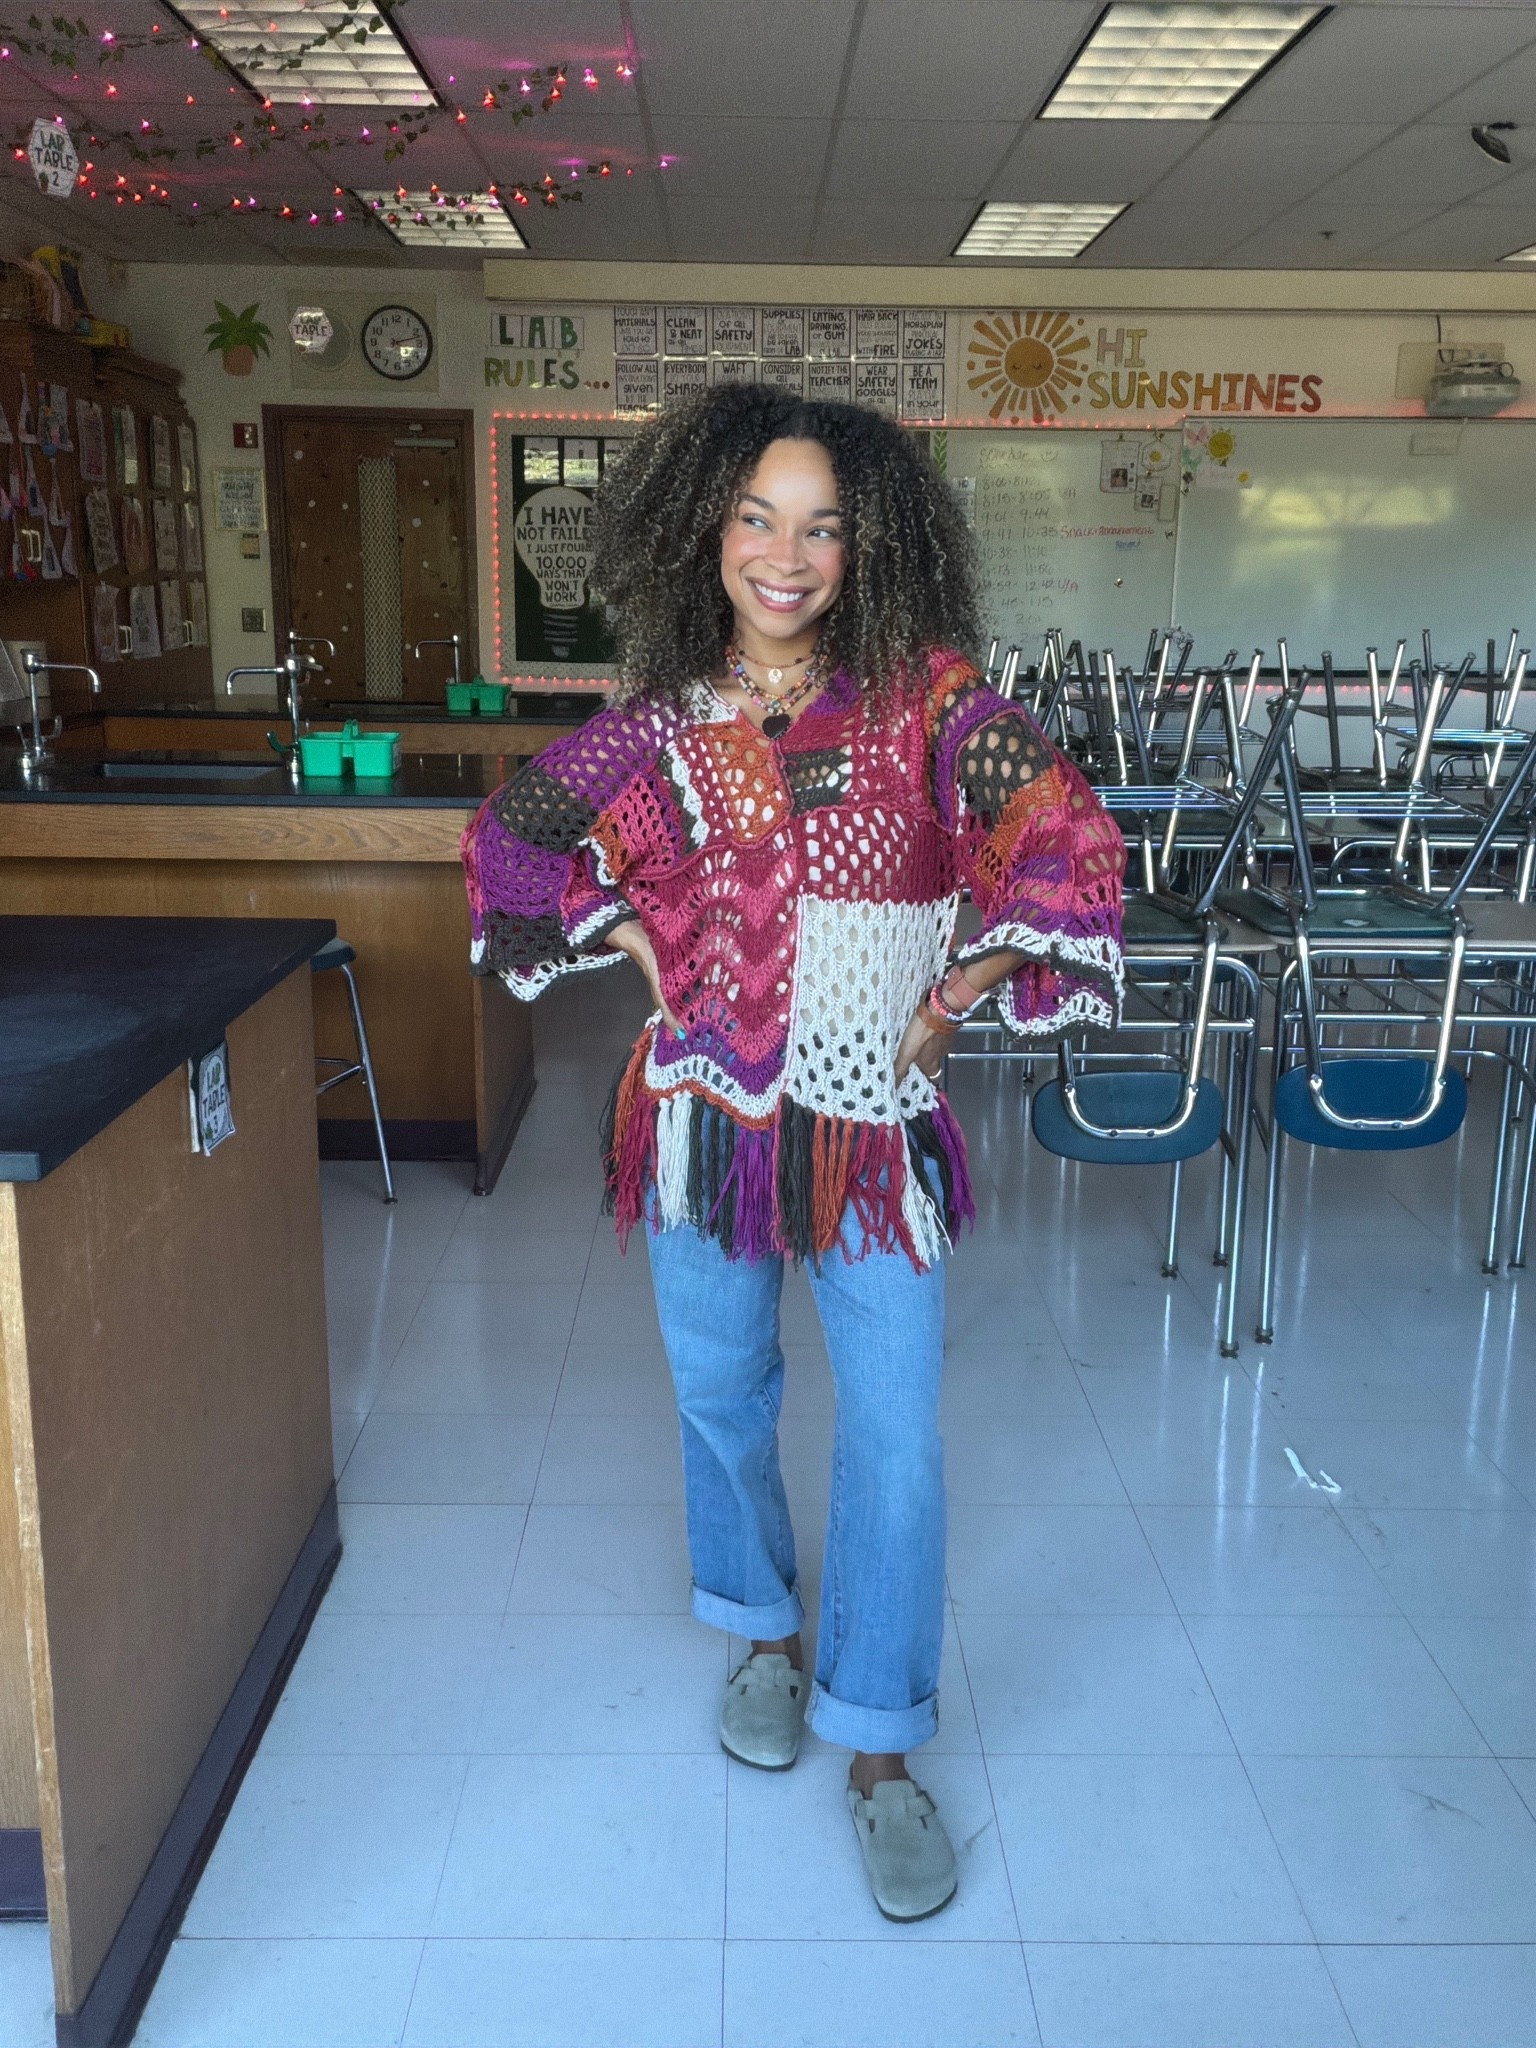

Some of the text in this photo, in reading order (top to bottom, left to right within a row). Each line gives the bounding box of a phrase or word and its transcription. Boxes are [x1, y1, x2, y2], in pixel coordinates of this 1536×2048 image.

[40, 130, 65, 151] LAB
[35, 147, 74, 171] TABLE
[52, 171, 60, 187] 2
[391, 314, 402, 324] 12
[858, 312, 876, 321] HAIR
[616, 318, 657, 327] MATERIALS
[666, 318, 696, 328] CLEAN
[294, 324, 328, 337] TABLE
[372, 327, 383, 336] 10
[500, 315, 578, 349] LAB
[680, 329, 703, 340] NEAT
[715, 329, 753, 341] SAFETY
[824, 331, 845, 340] GUM
[905, 338, 943, 350] JOKES
[1097, 327, 1148, 368] HI
[785, 345, 801, 355] LAB
[873, 344, 896, 356] FIRE
[617, 363, 643, 373] FOLLOW
[666, 363, 707, 374] EVERYBODY
[722, 361, 747, 374] WAFT
[763, 364, 801, 374] CONSIDER
[811, 365, 848, 374] NOTIFY THE
[865, 366, 888, 376] WEAR
[912, 365, 932, 377] BE A
[810, 376, 851, 386] TEACHER
[858, 377, 896, 388] SAFETY
[909, 377, 938, 389] TEAM
[623, 383, 654, 394] given
[666, 383, 705, 396] SHARE
[857, 388, 897, 397] GOGGLES
[1087, 370, 1323, 413] SUNSHINES
[524, 506, 596, 526] I HAVE
[516, 526, 545, 541] NOT
[527, 543, 532, 553] I
[535, 543, 559, 554] JUST
[536, 556, 587, 570] 10,000
[536, 568, 586, 579] WAYS THAT
[545, 580, 578, 591] WON'T
[545, 590, 577, 602] WORK
[203, 1083, 226, 1118] TABLE
[213, 1114, 219, 1134] 3
